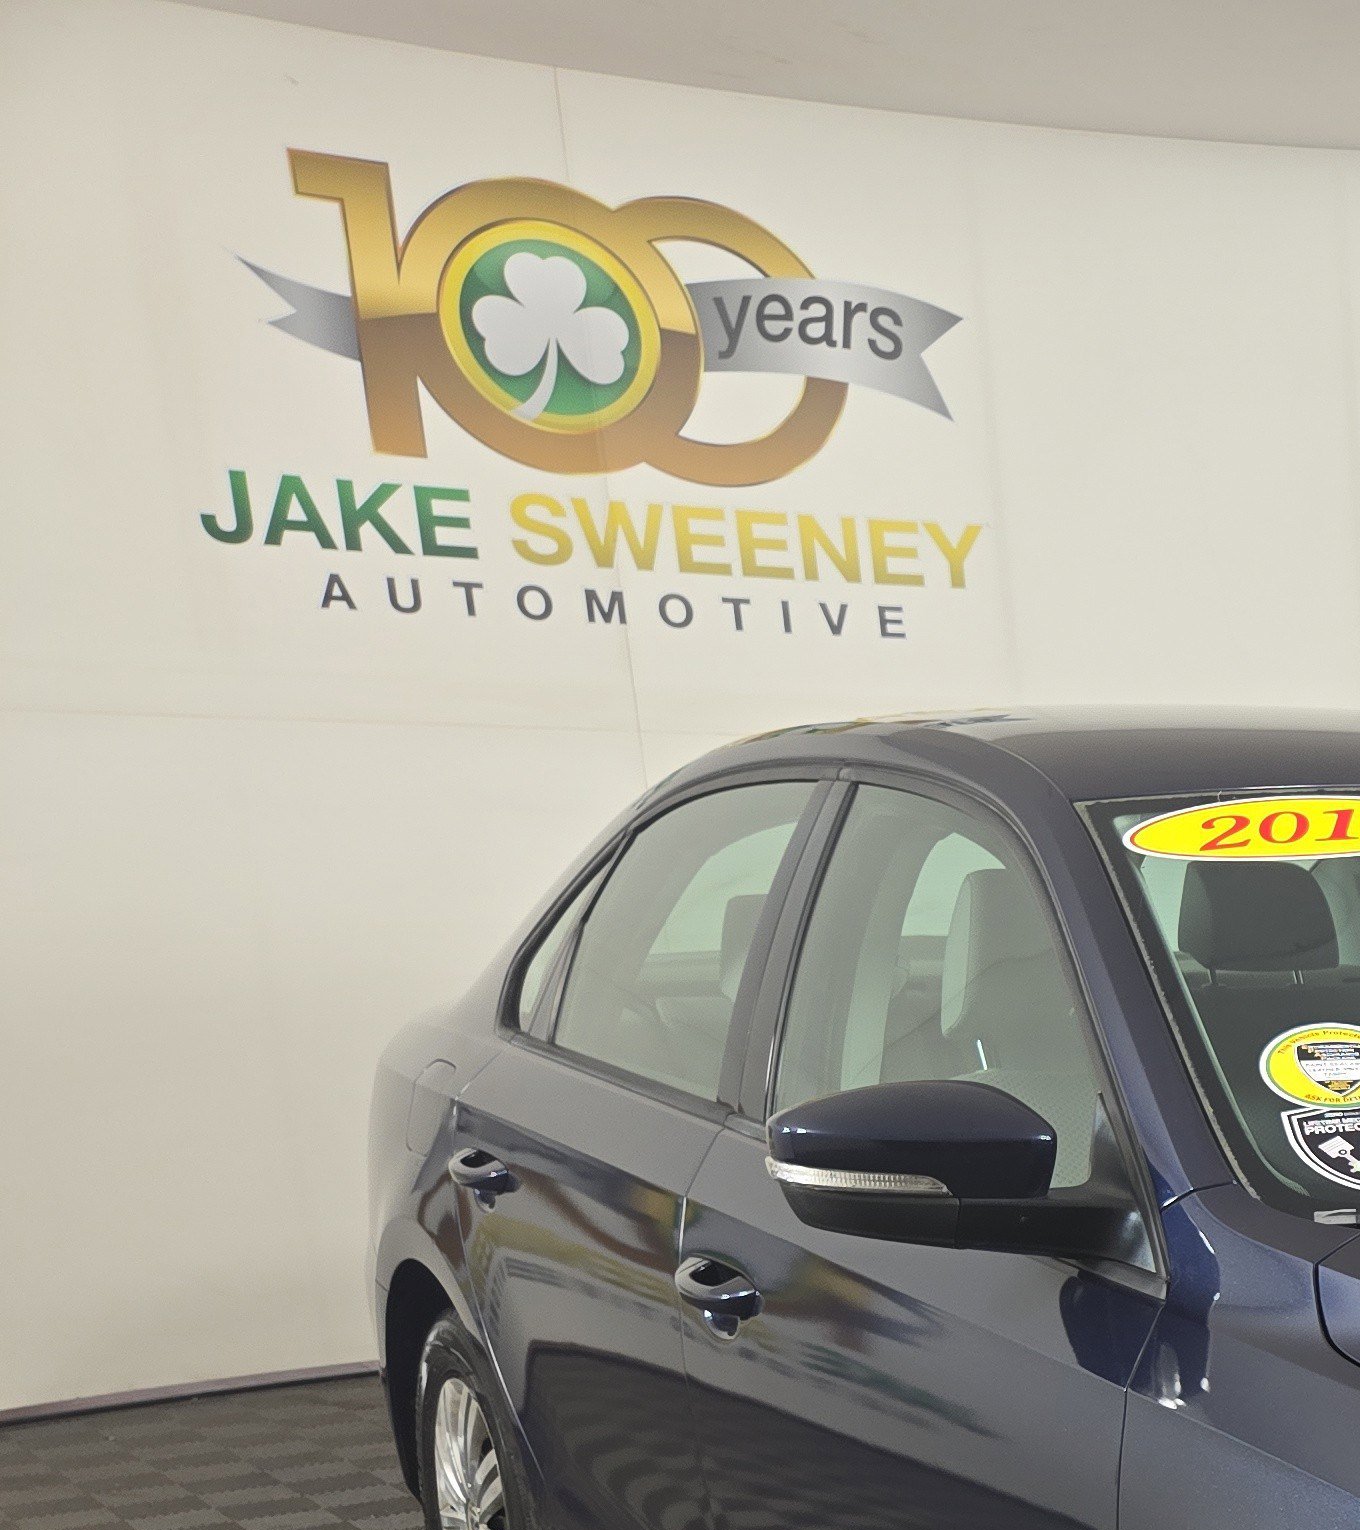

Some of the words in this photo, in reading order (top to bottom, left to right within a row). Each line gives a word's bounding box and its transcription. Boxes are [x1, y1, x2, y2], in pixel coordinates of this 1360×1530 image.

[713, 291, 905, 361] years
[200, 469, 480, 561] JAKE
[508, 491, 983, 590] SWEENEY
[320, 572, 907, 640] AUTOMOTIVE
